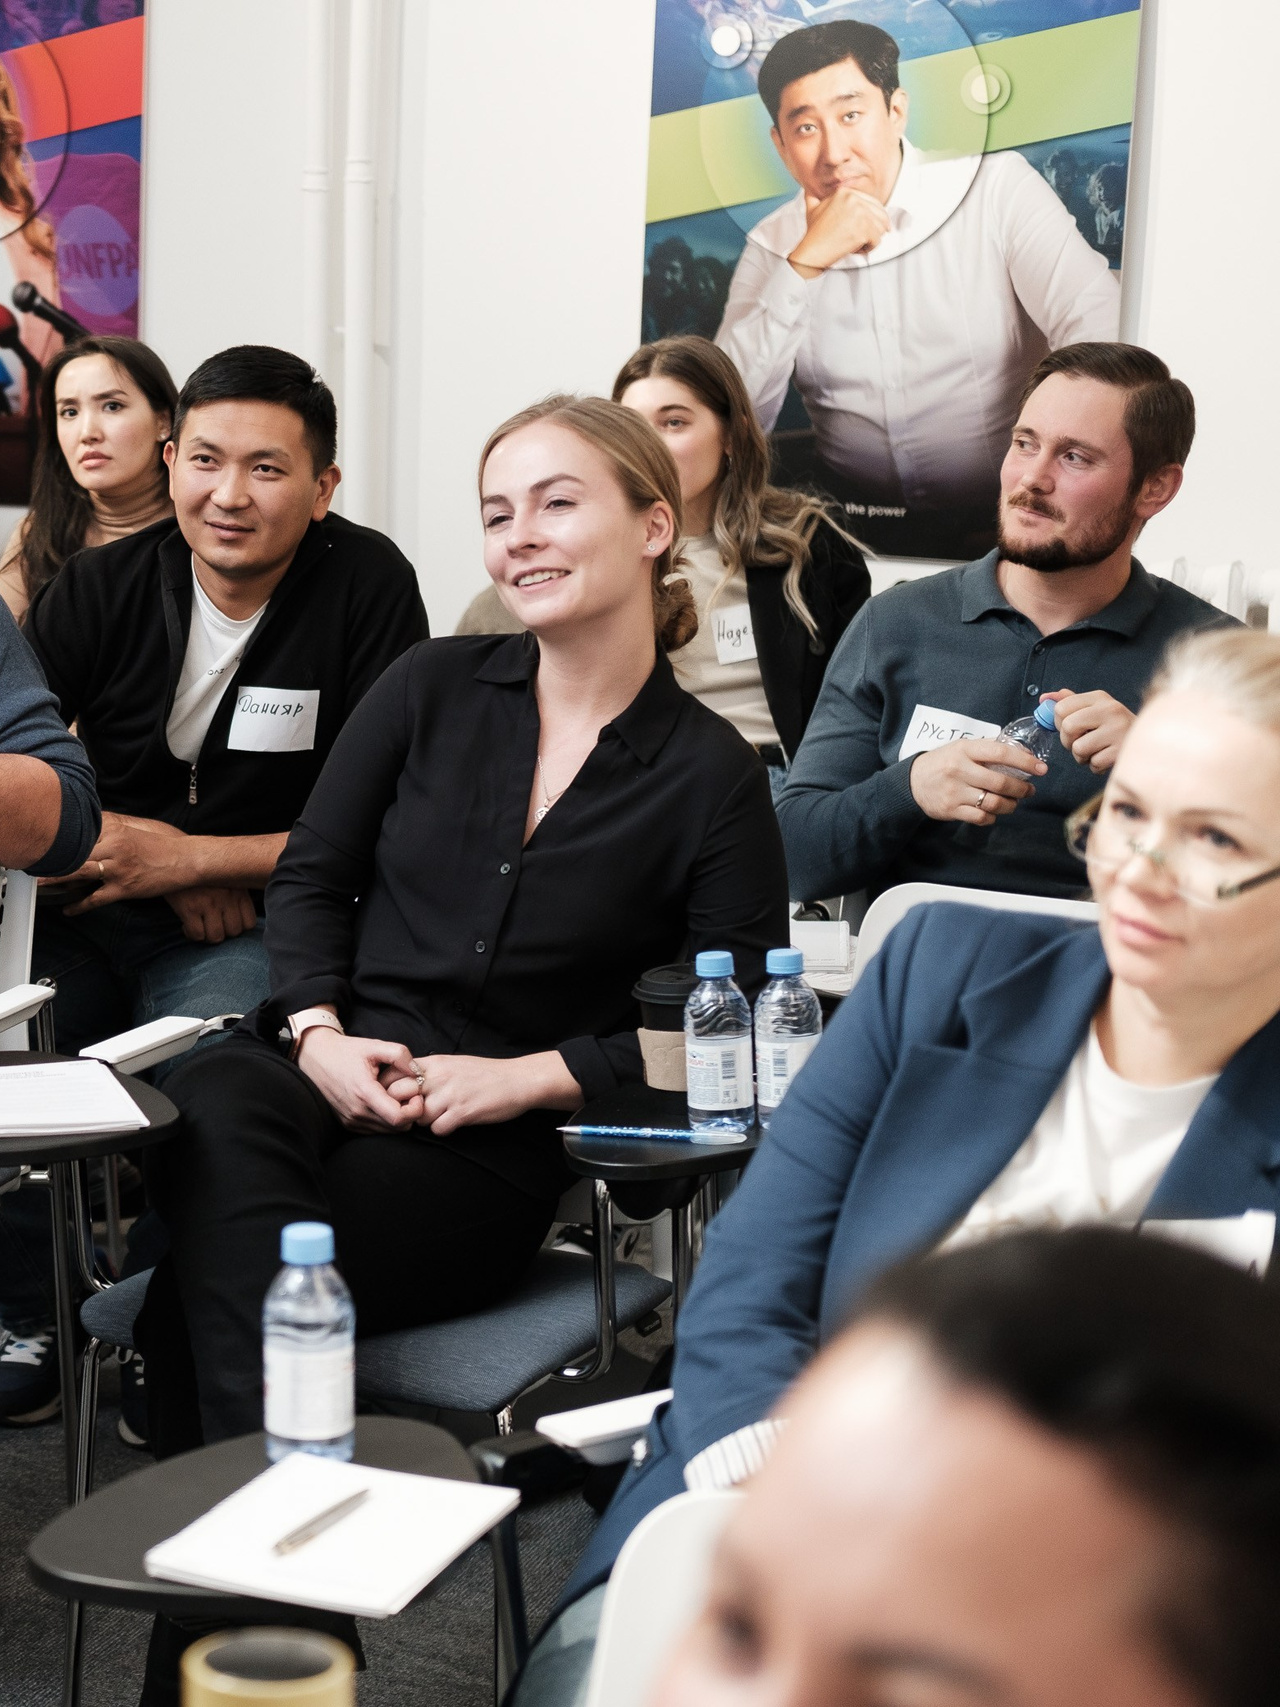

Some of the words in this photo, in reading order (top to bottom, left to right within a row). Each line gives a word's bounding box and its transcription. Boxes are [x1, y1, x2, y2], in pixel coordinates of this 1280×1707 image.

[845, 502, 866, 516] the
[868, 505, 907, 518] power
[238, 694, 304, 718] Данияр
